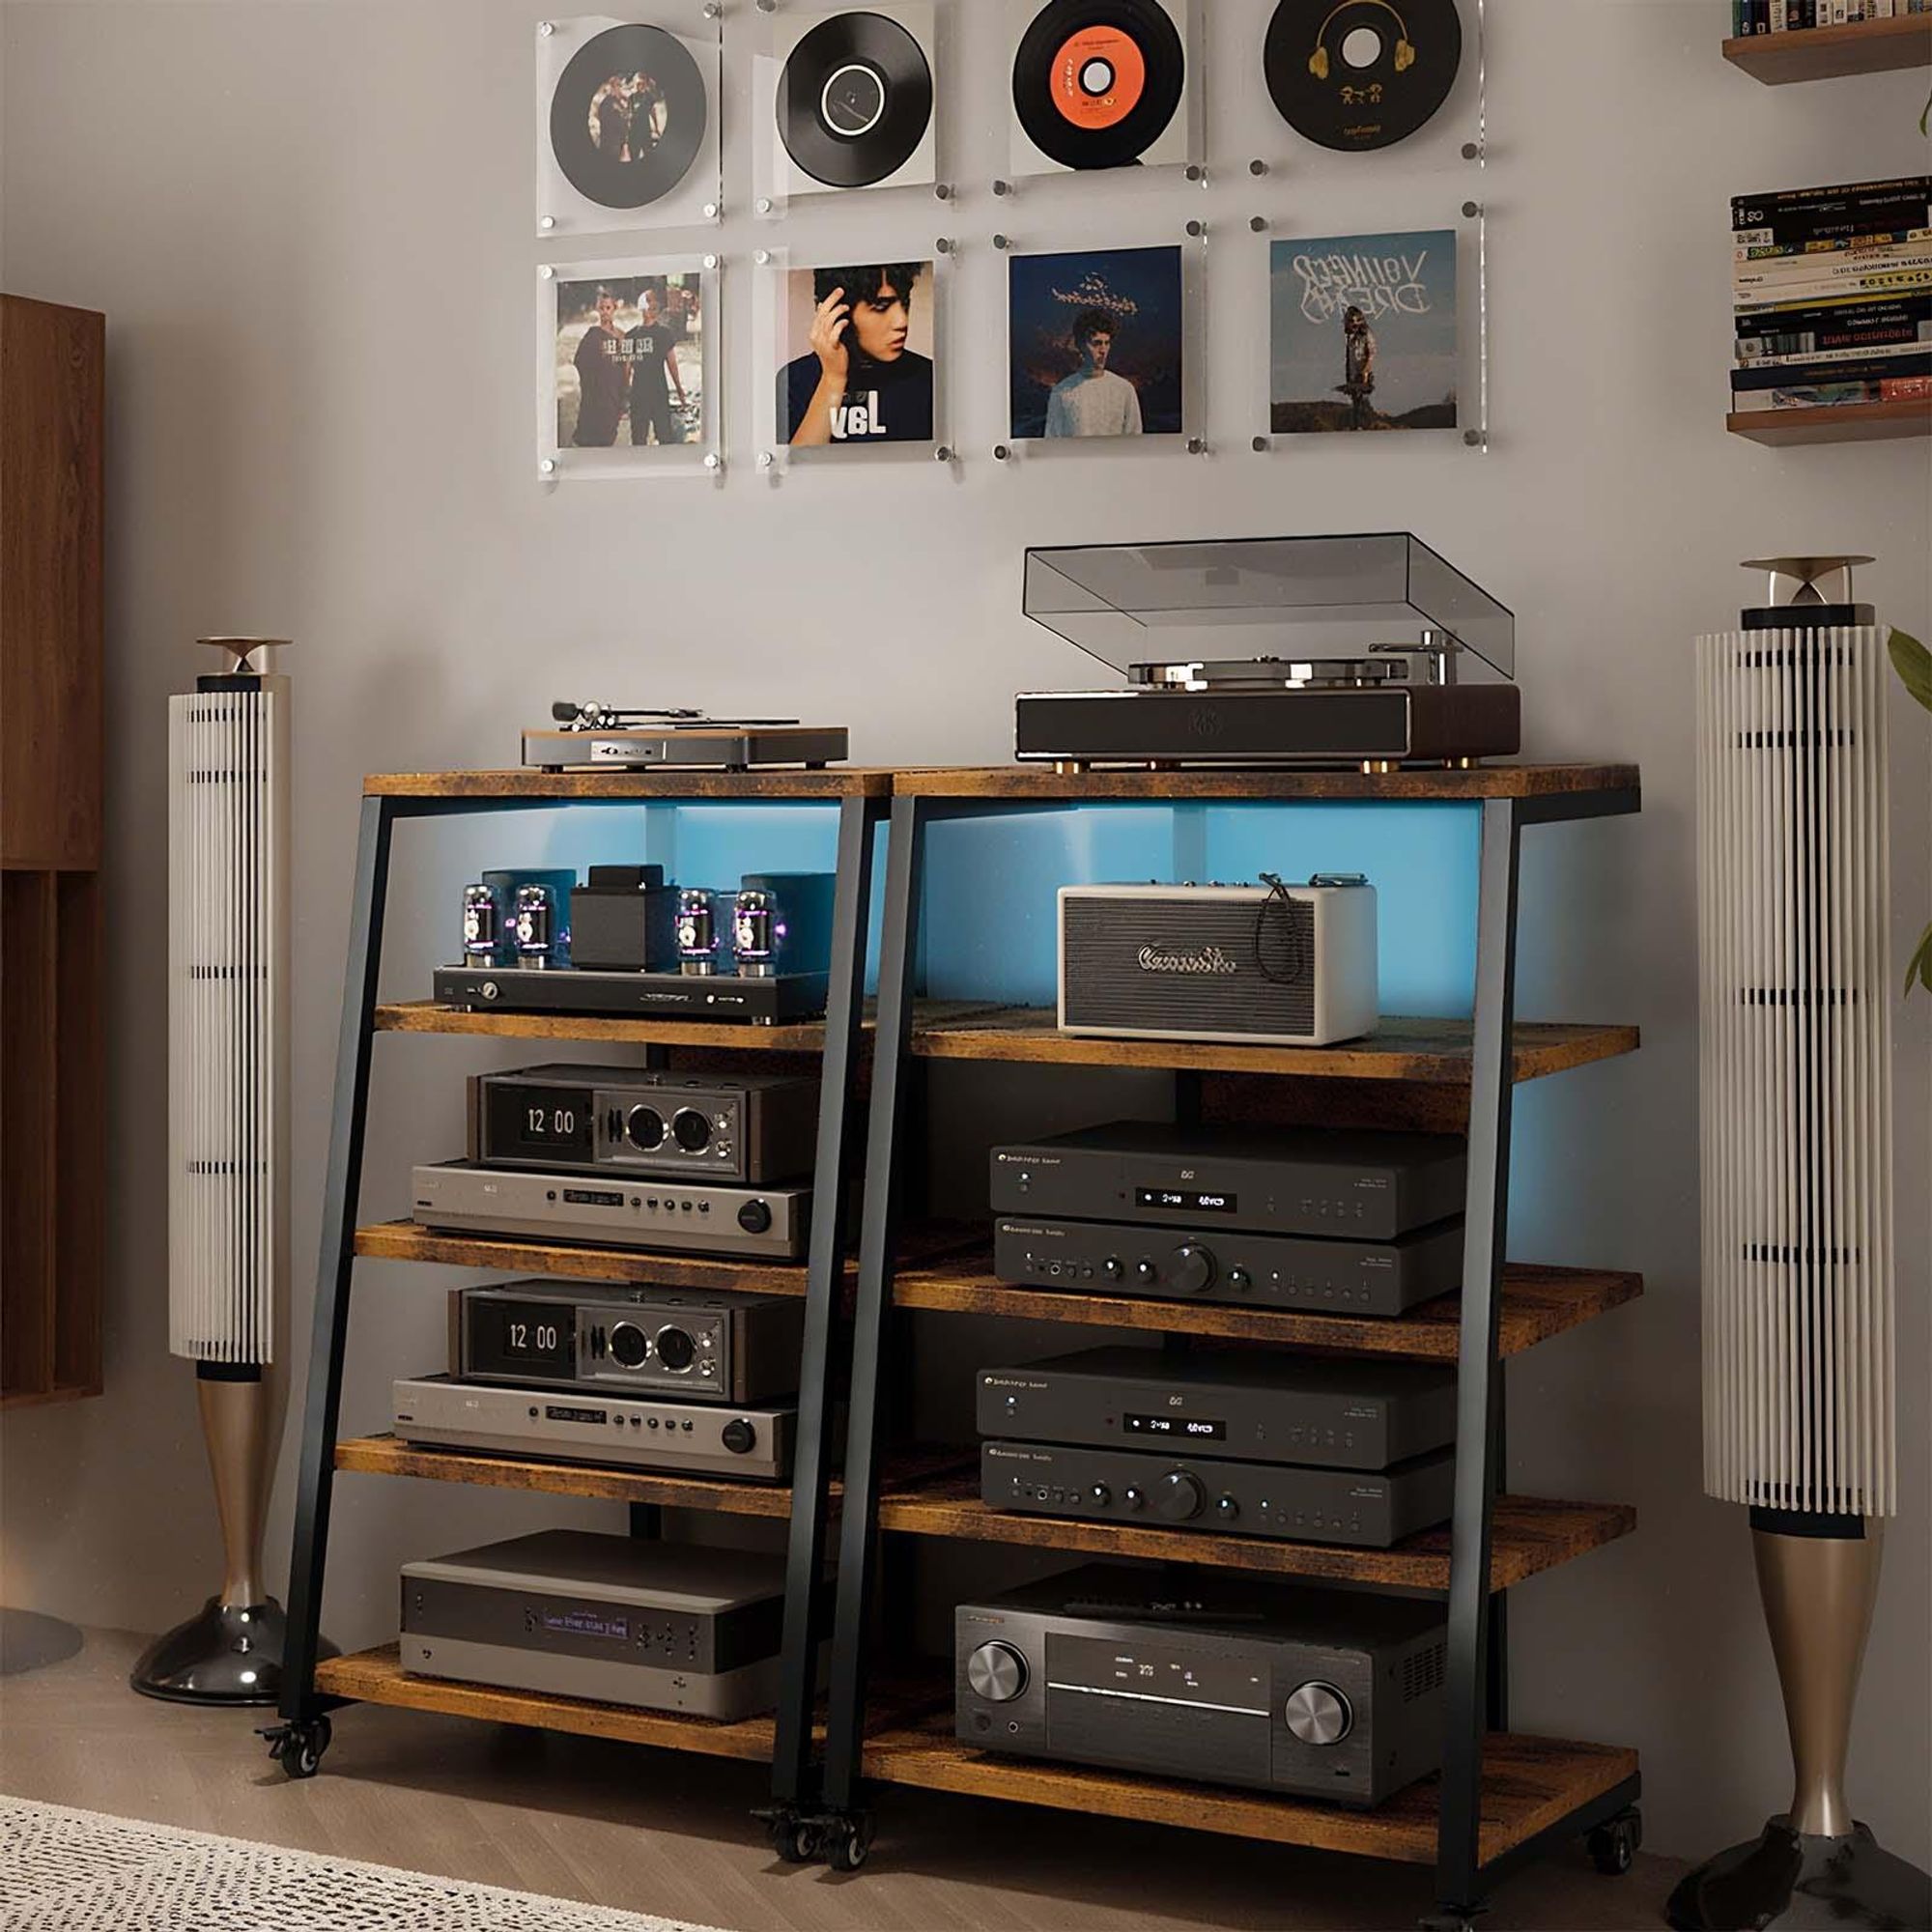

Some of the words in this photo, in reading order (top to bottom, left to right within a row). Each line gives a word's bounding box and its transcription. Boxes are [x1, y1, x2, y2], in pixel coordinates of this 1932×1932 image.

[528, 1109, 545, 1132] 12
[554, 1110, 575, 1133] 00
[510, 1323, 527, 1349] 12
[537, 1325, 556, 1350] 00
